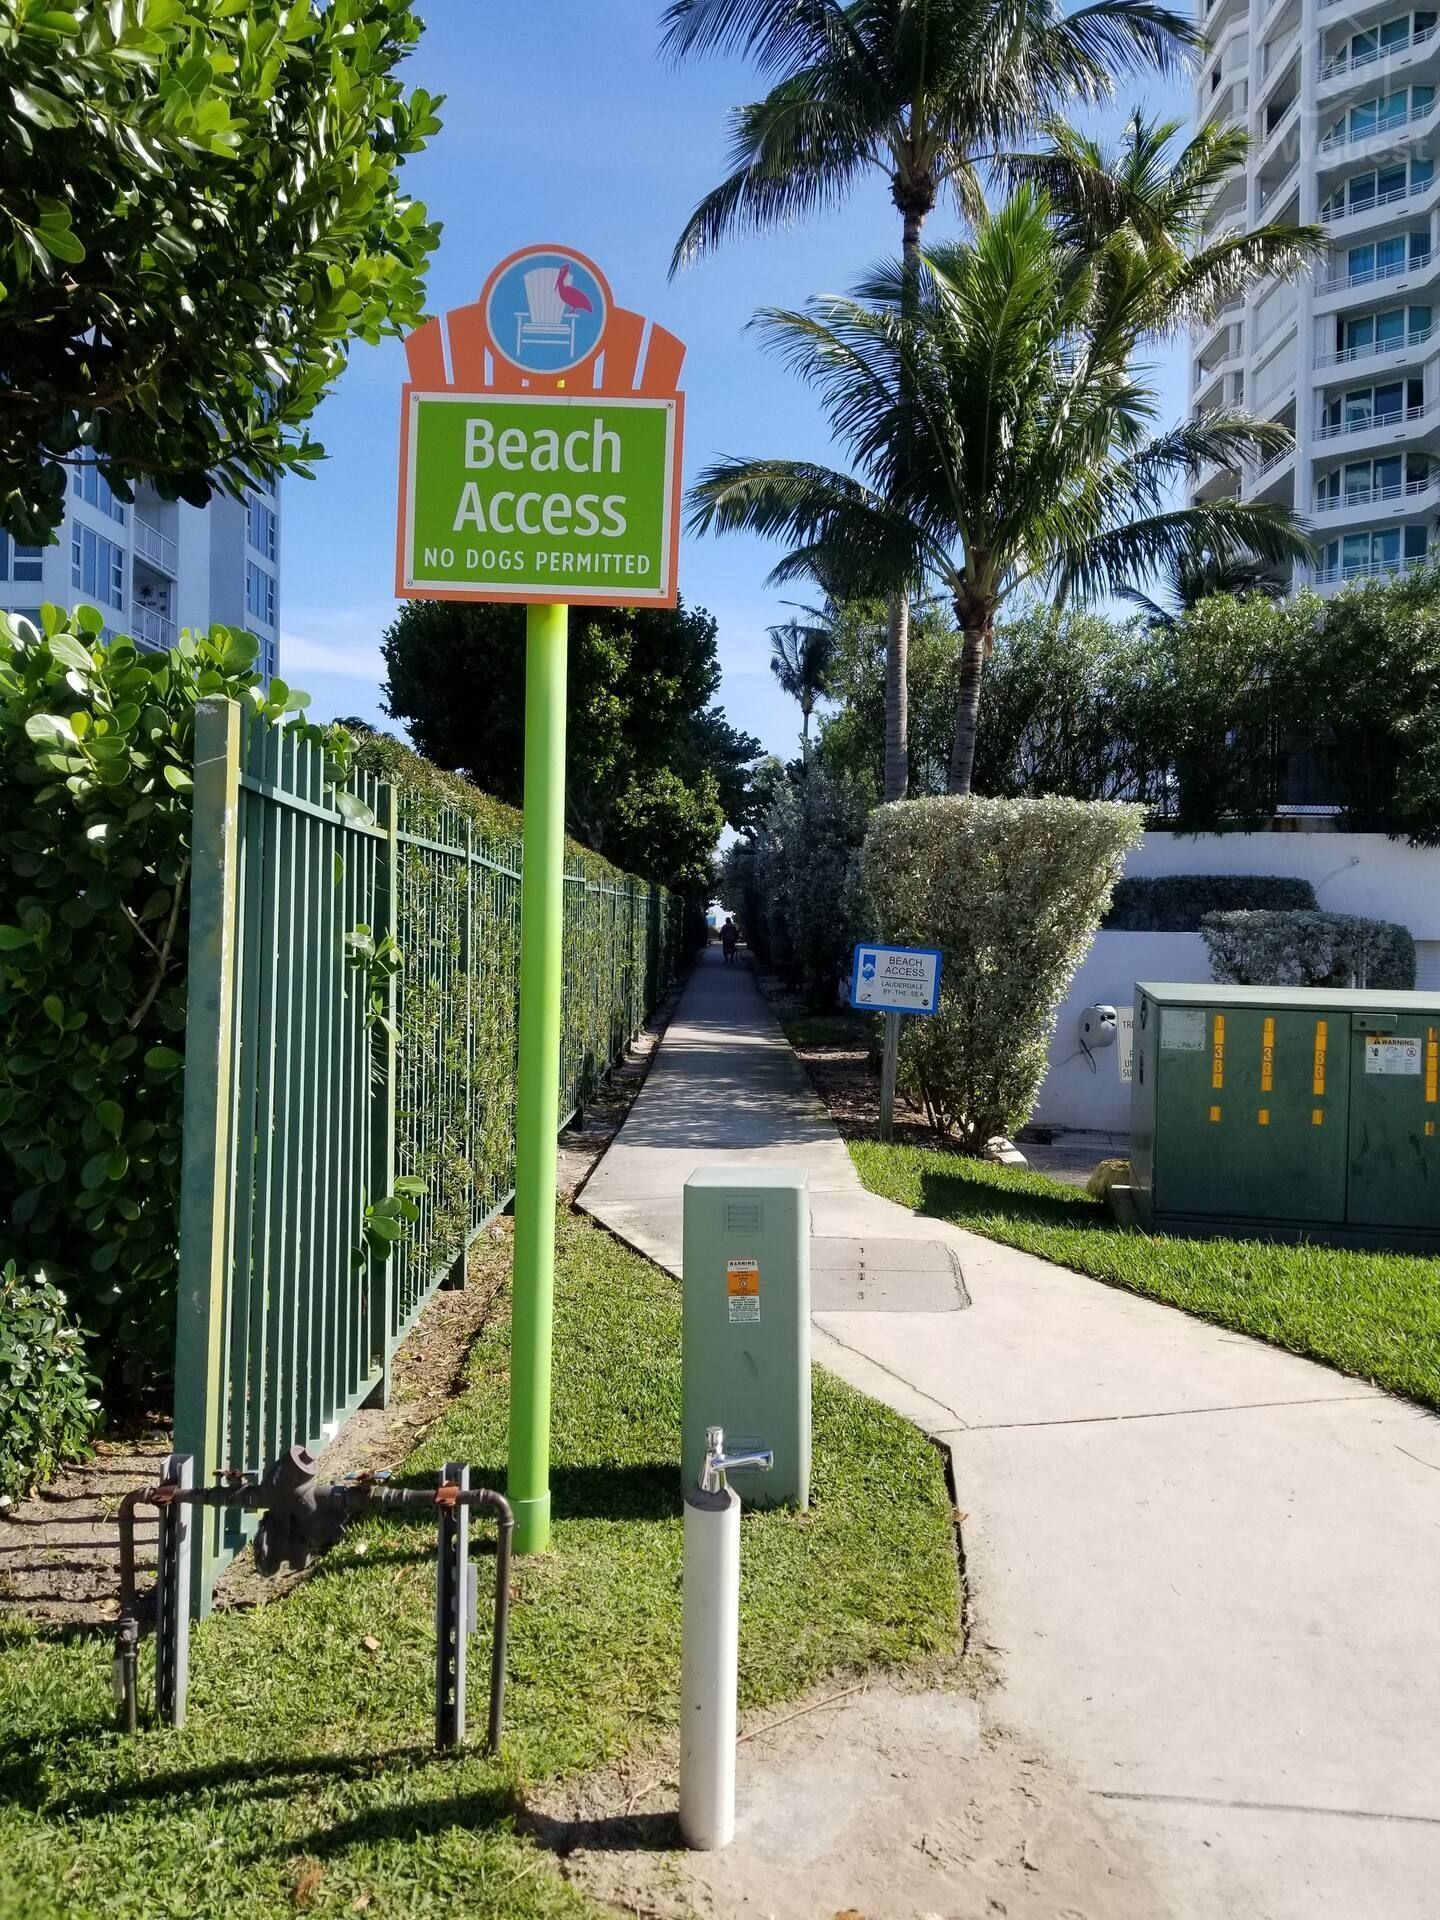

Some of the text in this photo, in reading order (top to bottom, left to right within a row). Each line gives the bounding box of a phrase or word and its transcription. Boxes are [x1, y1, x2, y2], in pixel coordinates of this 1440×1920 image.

[464, 417, 622, 473] Beach
[452, 481, 628, 537] Access
[423, 547, 651, 575] NO DOGS PERMITTED
[889, 956, 923, 967] BEACH
[884, 966, 925, 977] ACCESS
[1382, 1039, 1415, 1047] WARNING
